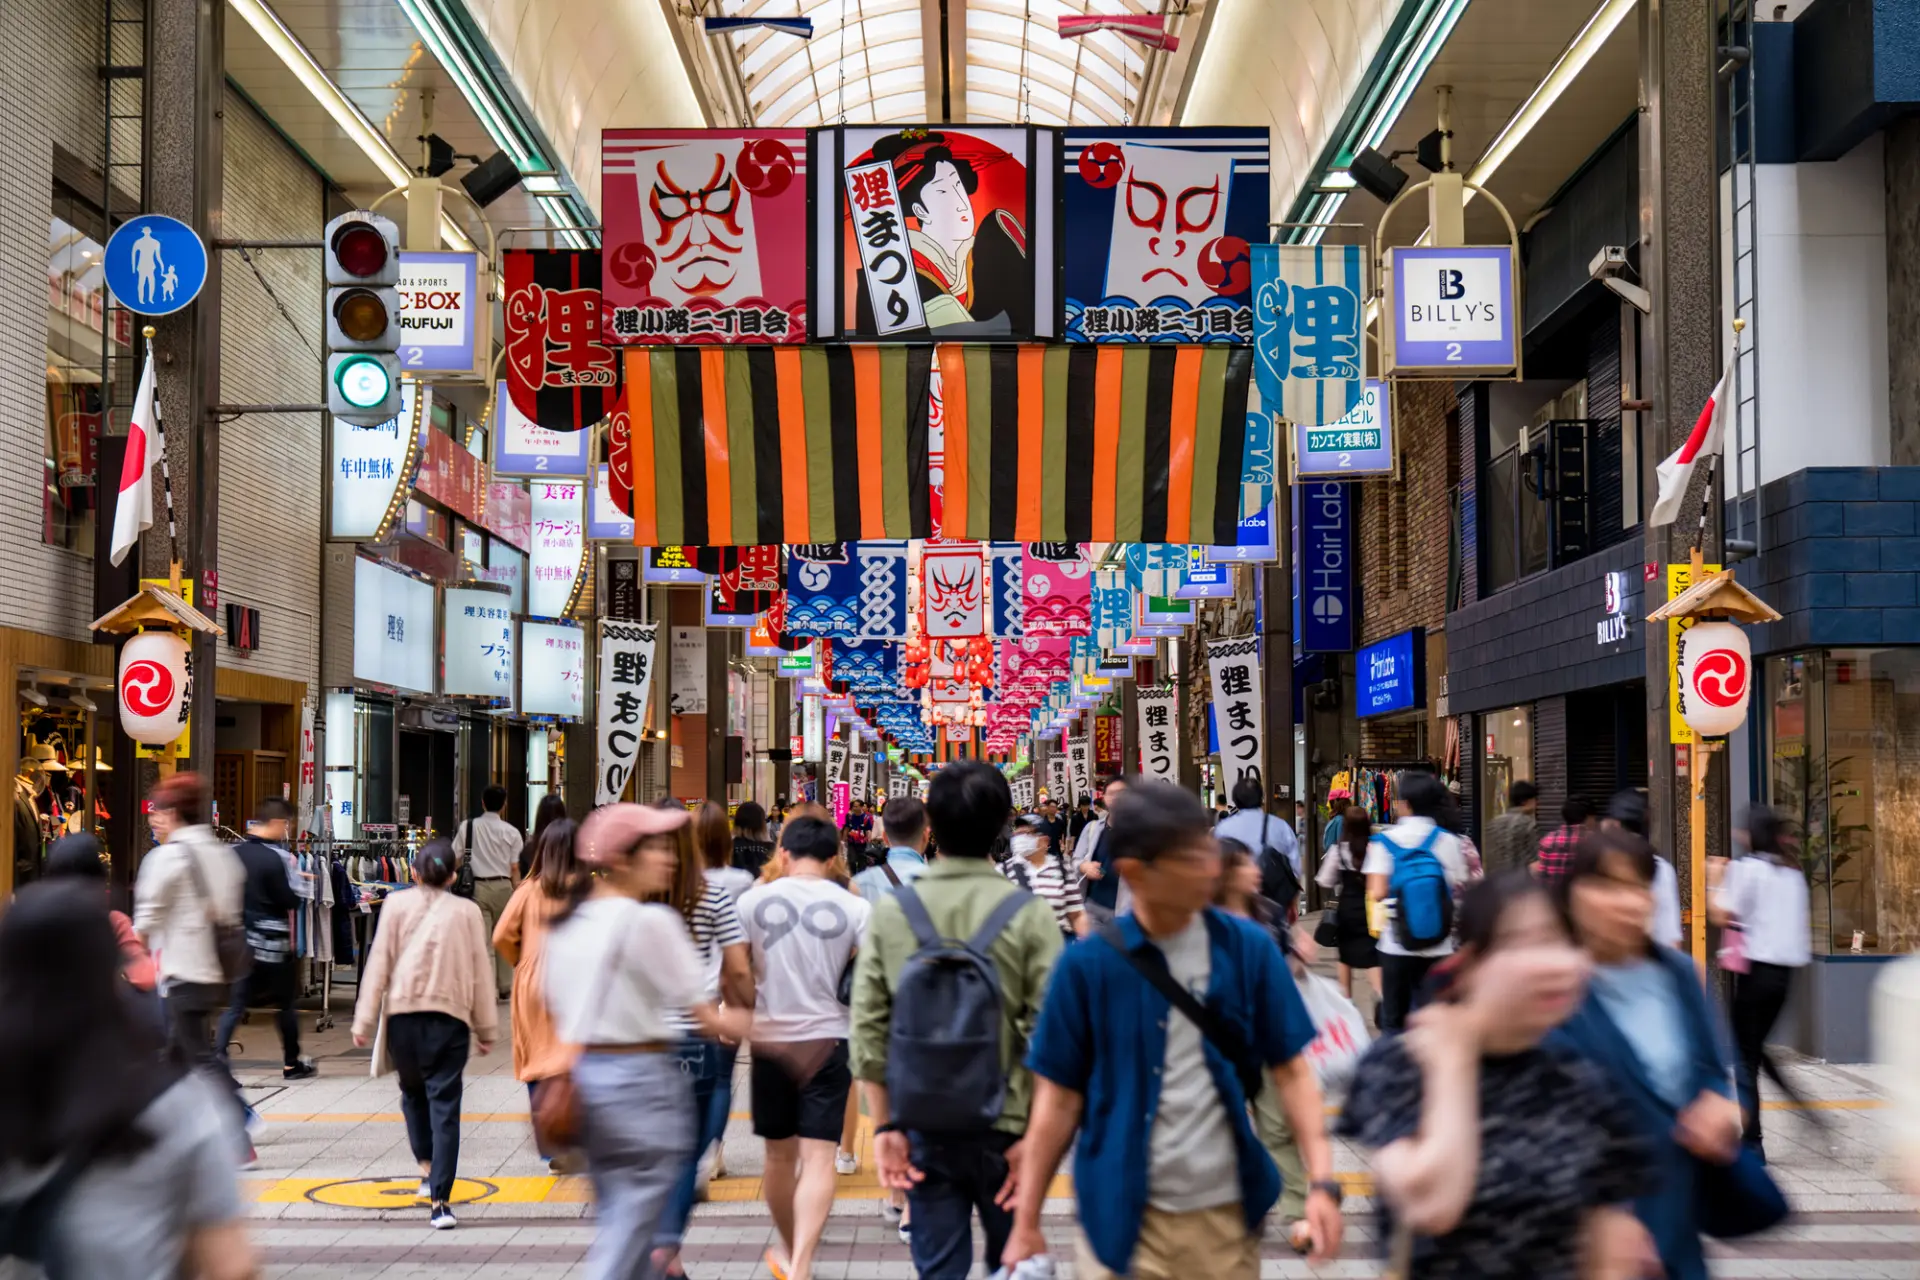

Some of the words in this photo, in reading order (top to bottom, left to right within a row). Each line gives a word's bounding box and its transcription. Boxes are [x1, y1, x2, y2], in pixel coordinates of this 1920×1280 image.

[851, 167, 909, 327] 狸まつり
[1439, 269, 1465, 300] B
[1411, 301, 1495, 322] BILLY'S
[614, 308, 788, 334] 狸小路二丁目会
[407, 347, 423, 365] 2
[1446, 342, 1462, 361] 2
[562, 370, 613, 385] まつり
[1306, 364, 1355, 378] まつり
[1310, 431, 1378, 449] カンエイ実業(株)
[340, 457, 394, 479] 年中無休
[535, 456, 548, 470] 2
[1338, 453, 1351, 467] 2
[543, 484, 576, 500] 美容
[535, 520, 581, 537] プラージュ
[619, 523, 630, 535] 2
[1236, 546, 1247, 558] 2
[535, 566, 573, 581] 年中無休
[670, 570, 680, 580] 2
[1200, 586, 1208, 595] 2
[728, 616, 735, 624] 2
[1597, 611, 1626, 645] BILLY'S
[1146, 705, 1170, 785] 狸まつ
[754, 895, 848, 950] 90
